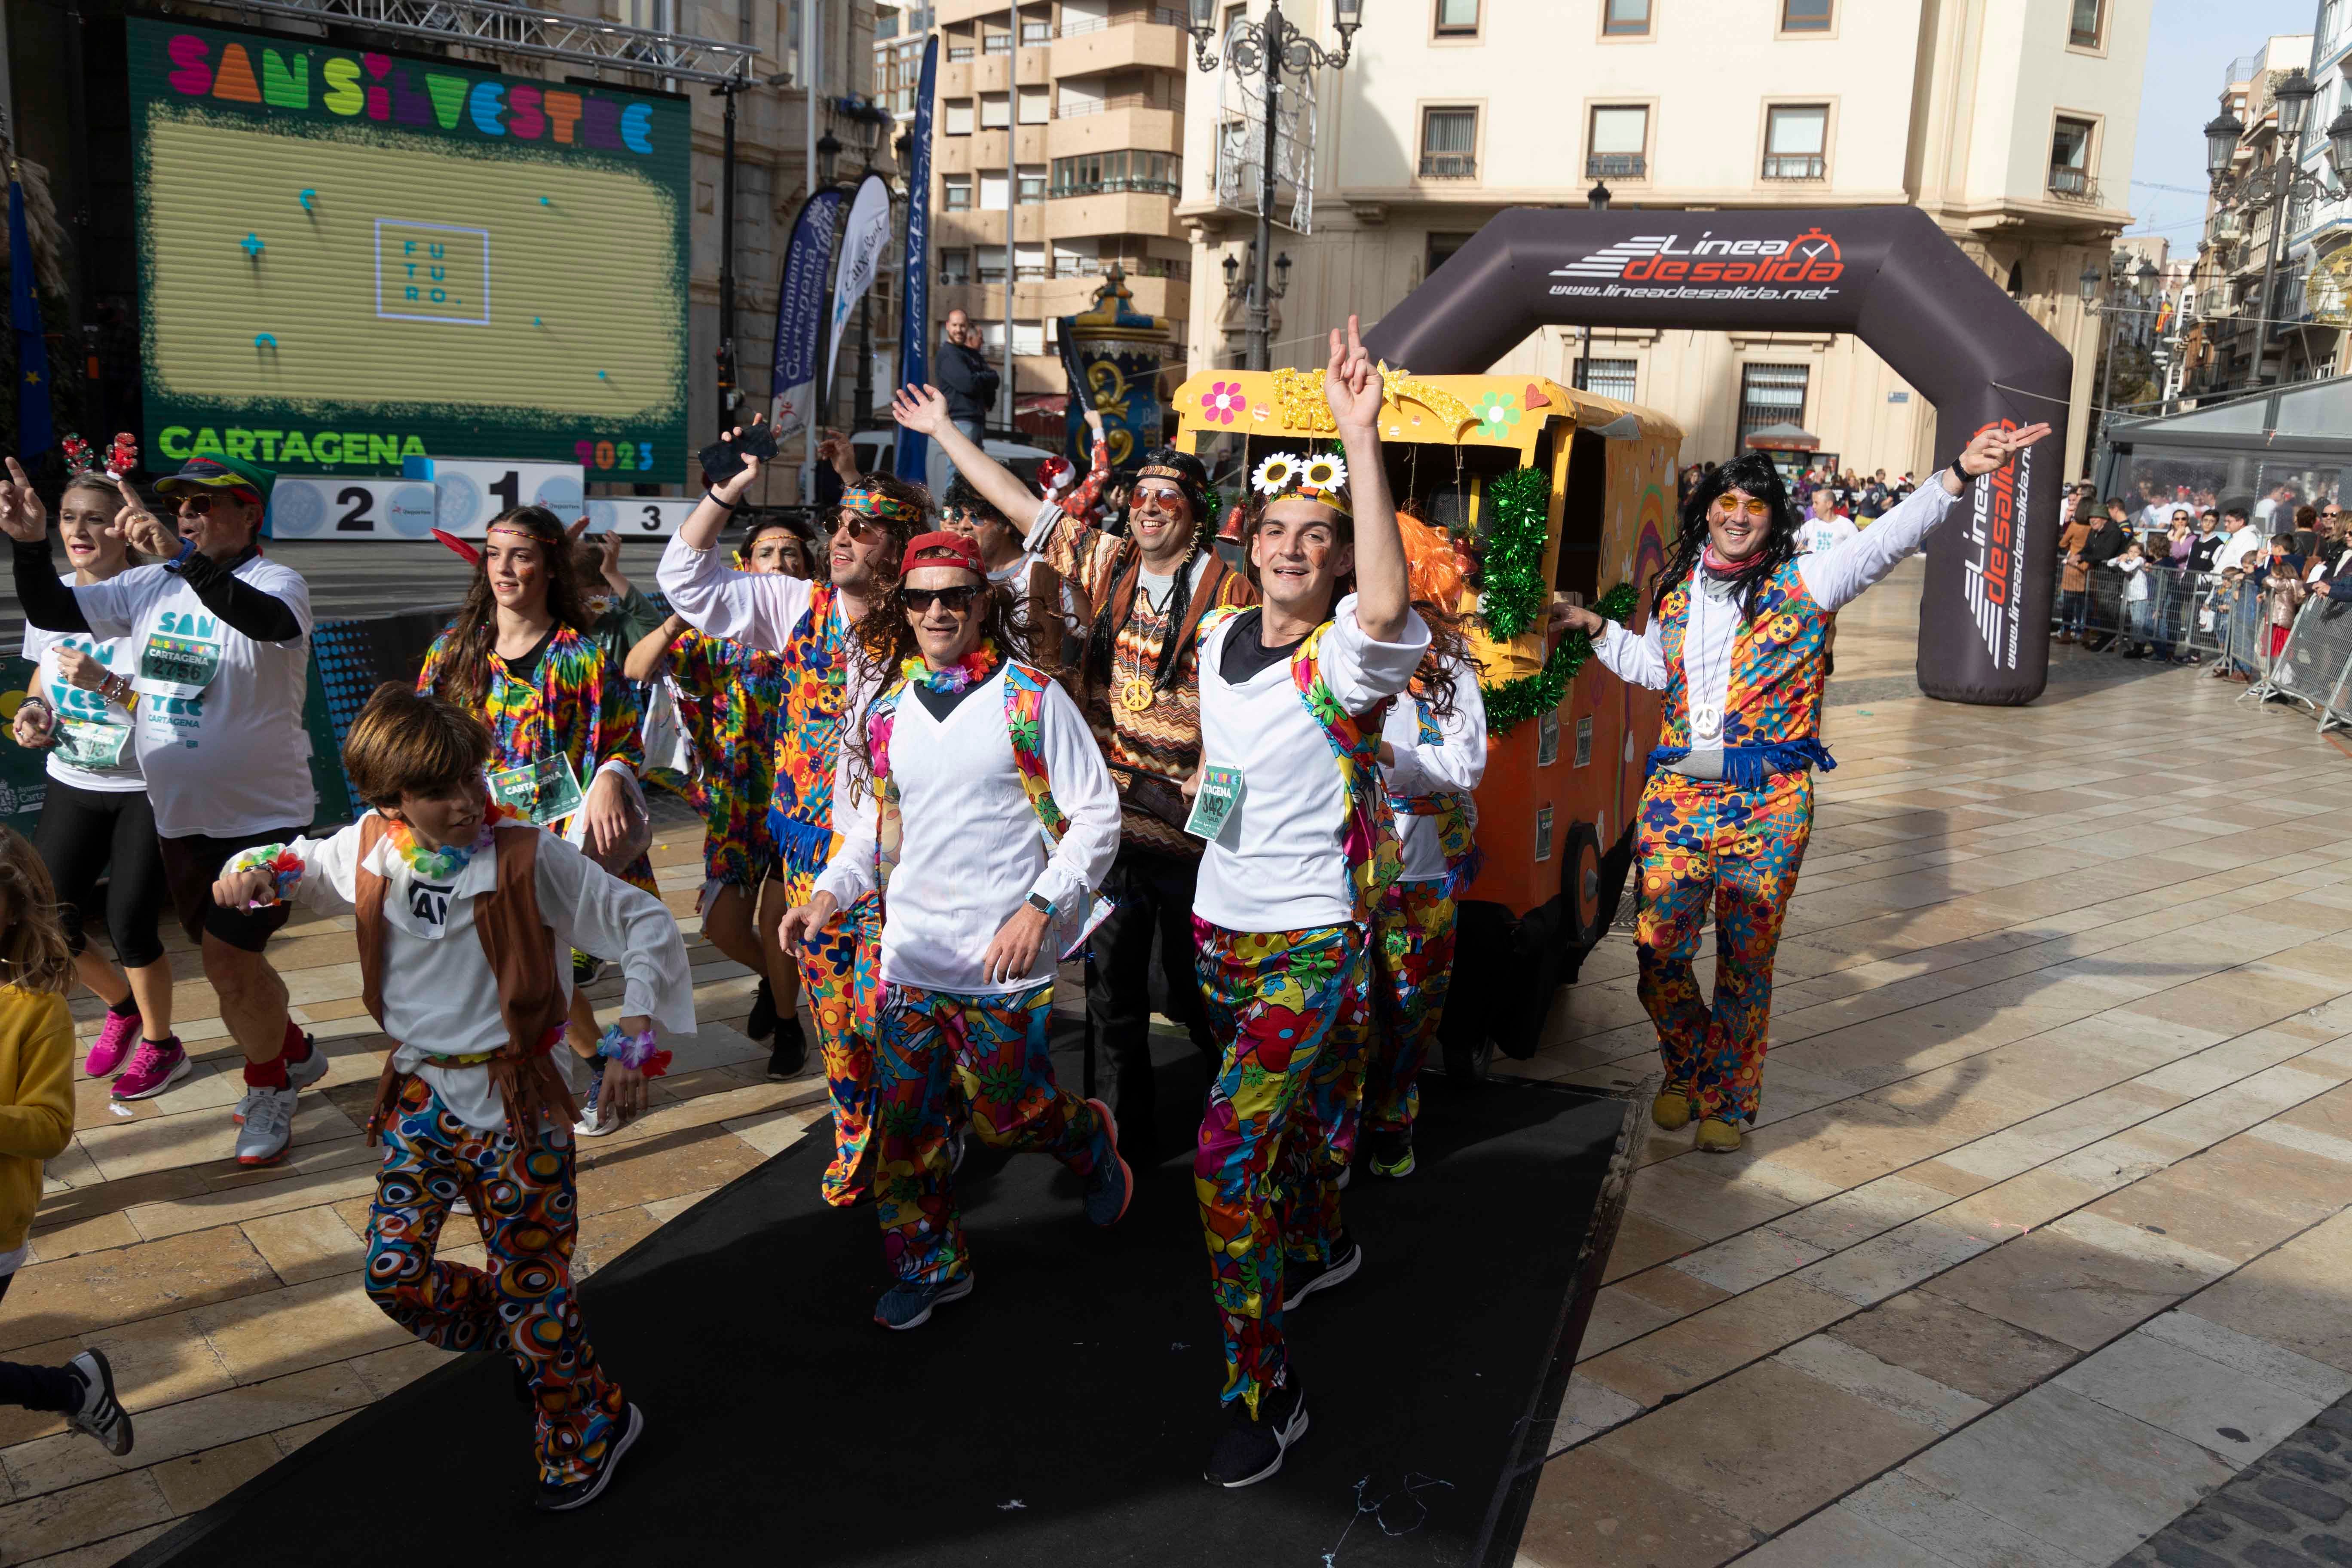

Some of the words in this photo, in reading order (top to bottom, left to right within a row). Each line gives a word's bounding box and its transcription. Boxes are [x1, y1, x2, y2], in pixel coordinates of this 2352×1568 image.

[168, 34, 309, 110] SAN
[1660, 231, 1789, 255] Línea
[1549, 284, 1840, 300] www.lineadesalida.net
[775, 240, 802, 377] Ayuntamiento
[158, 425, 427, 465] CARTAGENA
[574, 440, 654, 472] 2023
[489, 471, 519, 513] 1
[1871, 491, 1880, 505] 9
[335, 486, 374, 532] 2
[640, 505, 661, 531] 3
[158, 611, 217, 638] SAN
[148, 648, 209, 666] CARTAGENA
[152, 658, 202, 680] 2756
[148, 714, 200, 729] CARTAGENA
